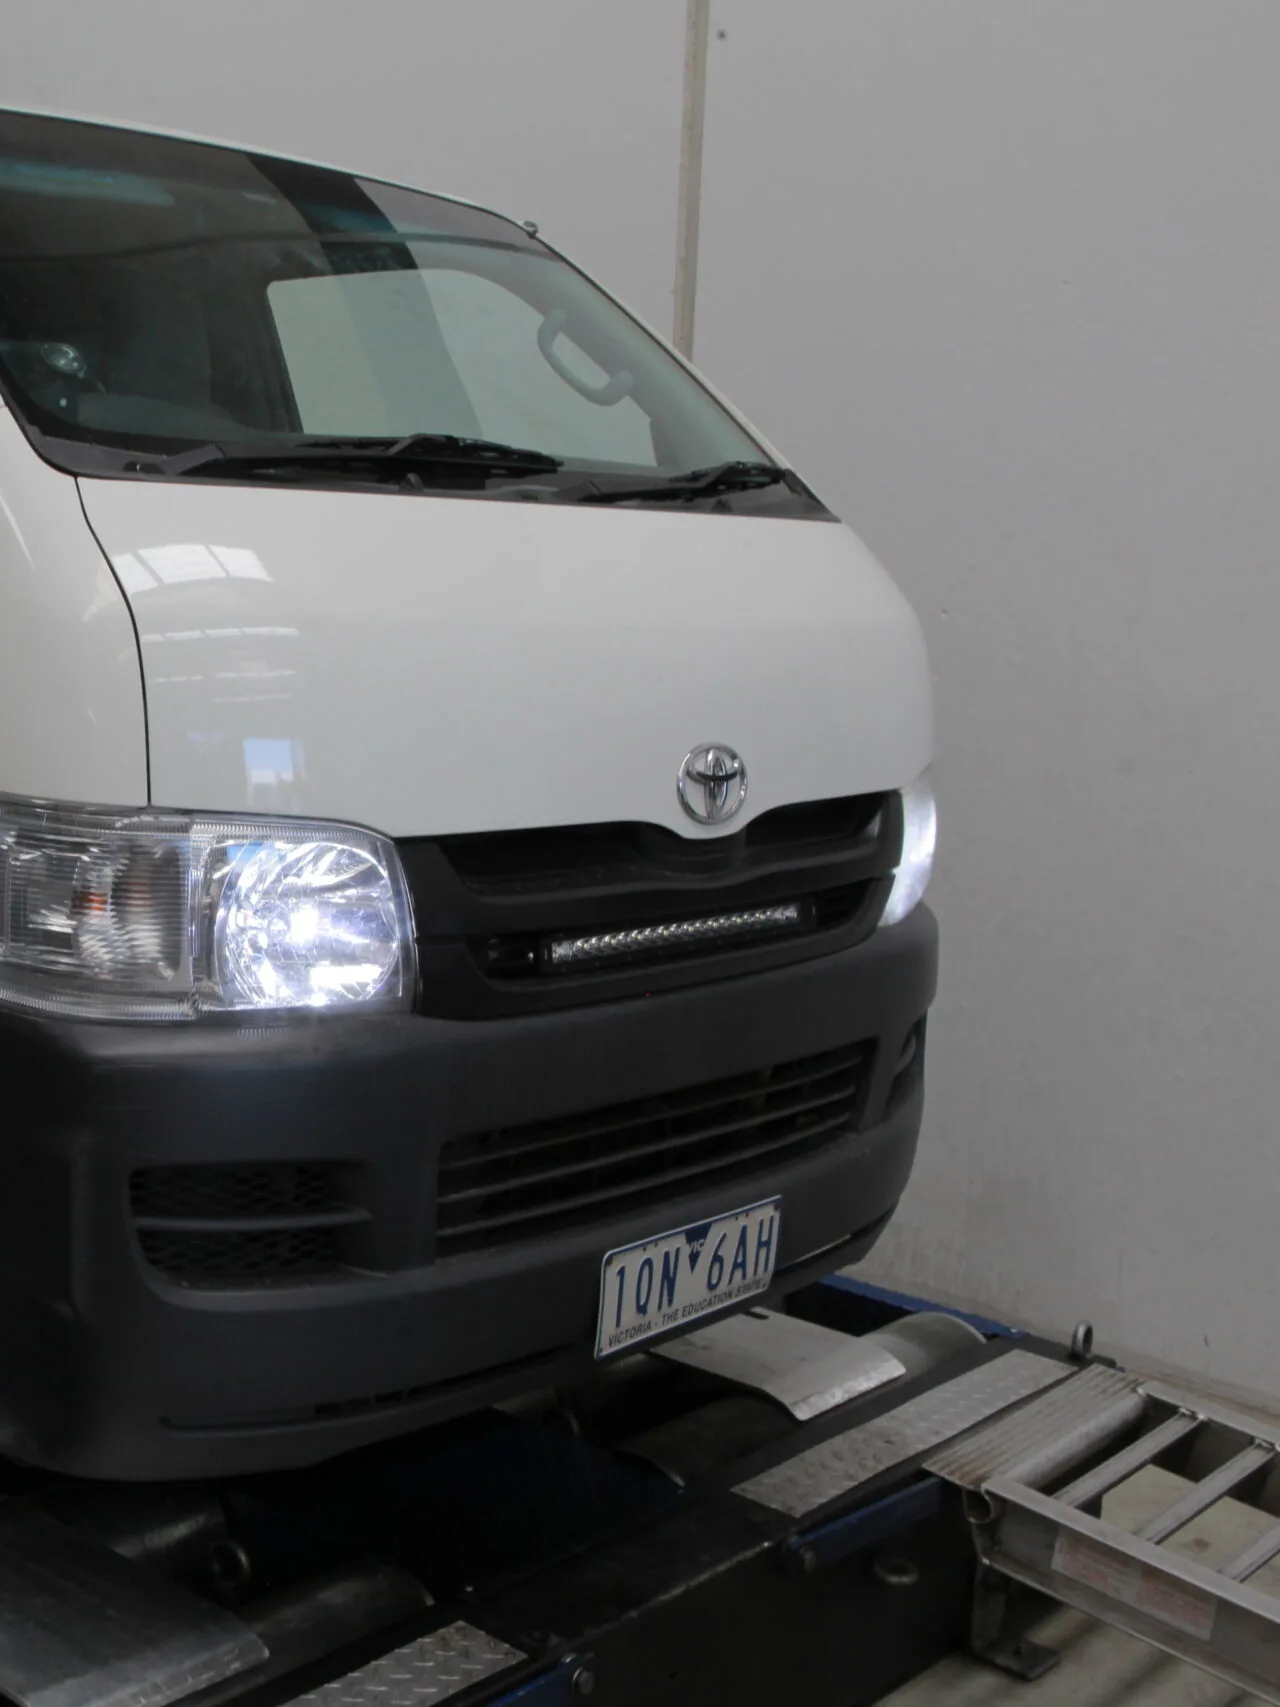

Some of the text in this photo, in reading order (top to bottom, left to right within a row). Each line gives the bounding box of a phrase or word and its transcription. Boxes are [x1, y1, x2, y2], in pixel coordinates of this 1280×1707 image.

[615, 1214, 774, 1329] 1QN 6AH
[608, 1321, 652, 1347] VICTORIA
[662, 1310, 679, 1327] THE
[682, 1290, 733, 1319] EDUCATION
